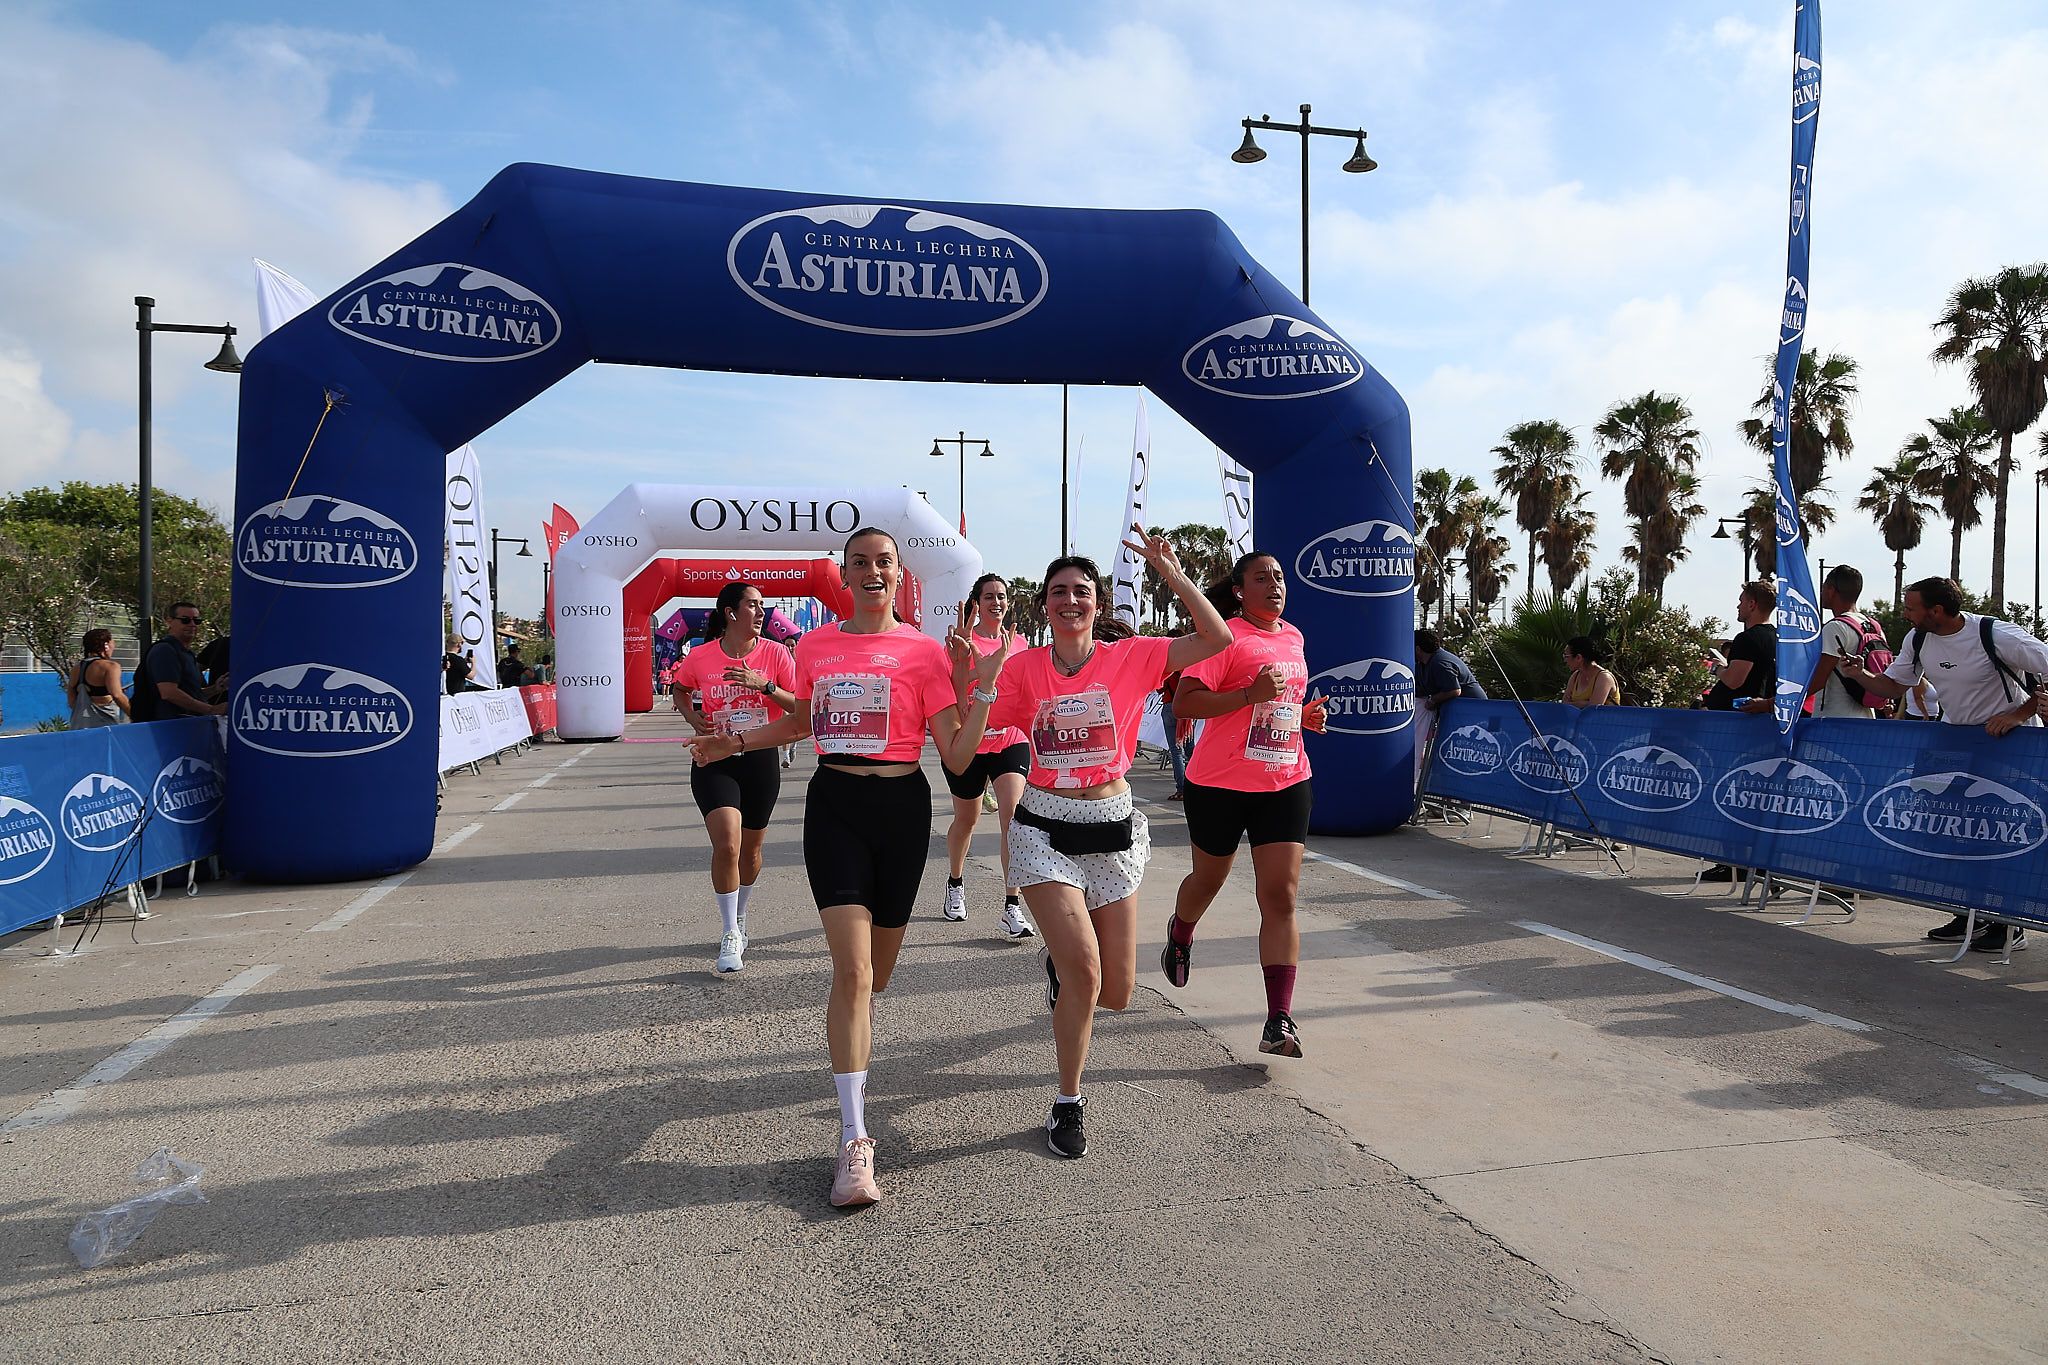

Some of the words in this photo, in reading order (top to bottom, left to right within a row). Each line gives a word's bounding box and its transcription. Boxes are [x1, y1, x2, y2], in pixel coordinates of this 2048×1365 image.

[804, 232, 906, 253] CENTRAL
[916, 240, 1015, 259] LECHERA
[752, 232, 1025, 304] ASTURIANA
[383, 291, 457, 305] CENTRAL
[465, 297, 540, 317] LECHERA
[341, 293, 543, 346] ASTURIANA
[1228, 343, 1290, 354] CENTRAL
[1295, 342, 1344, 353] LECHERA
[1197, 348, 1357, 380] ASTURIANA
[690, 498, 861, 533] OYSHO
[264, 526, 327, 536] CENTRAL
[334, 528, 401, 543] LECHERA
[584, 535, 638, 548] OYSHO
[243, 528, 406, 570] ASTURIANA
[907, 537, 956, 548] OYSHO
[1333, 547, 1384, 555] CENTRAL
[683, 568, 723, 582] Sports
[742, 569, 806, 579] Santander
[561, 605, 611, 617] OYSHO
[933, 605, 959, 616] OYS
[815, 655, 844, 668] OYSHO
[562, 675, 612, 687] OYSHO
[832, 688, 863, 696] ASTURIANA
[1331, 684, 1381, 693] CENTRAL
[259, 694, 322, 705] CENTRAL
[329, 696, 396, 706] LECHERA
[238, 696, 401, 733] ASTURIANA
[1056, 705, 1087, 714] ASTURIANA
[830, 711, 860, 725] 016
[1058, 728, 1089, 742] 016
[1271, 729, 1291, 741] 016
[1044, 757, 1069, 765] OYSHO
[1602, 765, 1691, 800] ASTURIANA
[1743, 780, 1784, 791] CENTRAL
[1788, 784, 1833, 797] LECHERA
[1720, 780, 1834, 821] ASTURIANA
[1906, 799, 1960, 811] CENTRAL
[1966, 804, 2029, 818] LECHERA
[6, 817, 40, 831] LECHERA
[1873, 797, 2030, 845] ASTURIANA
